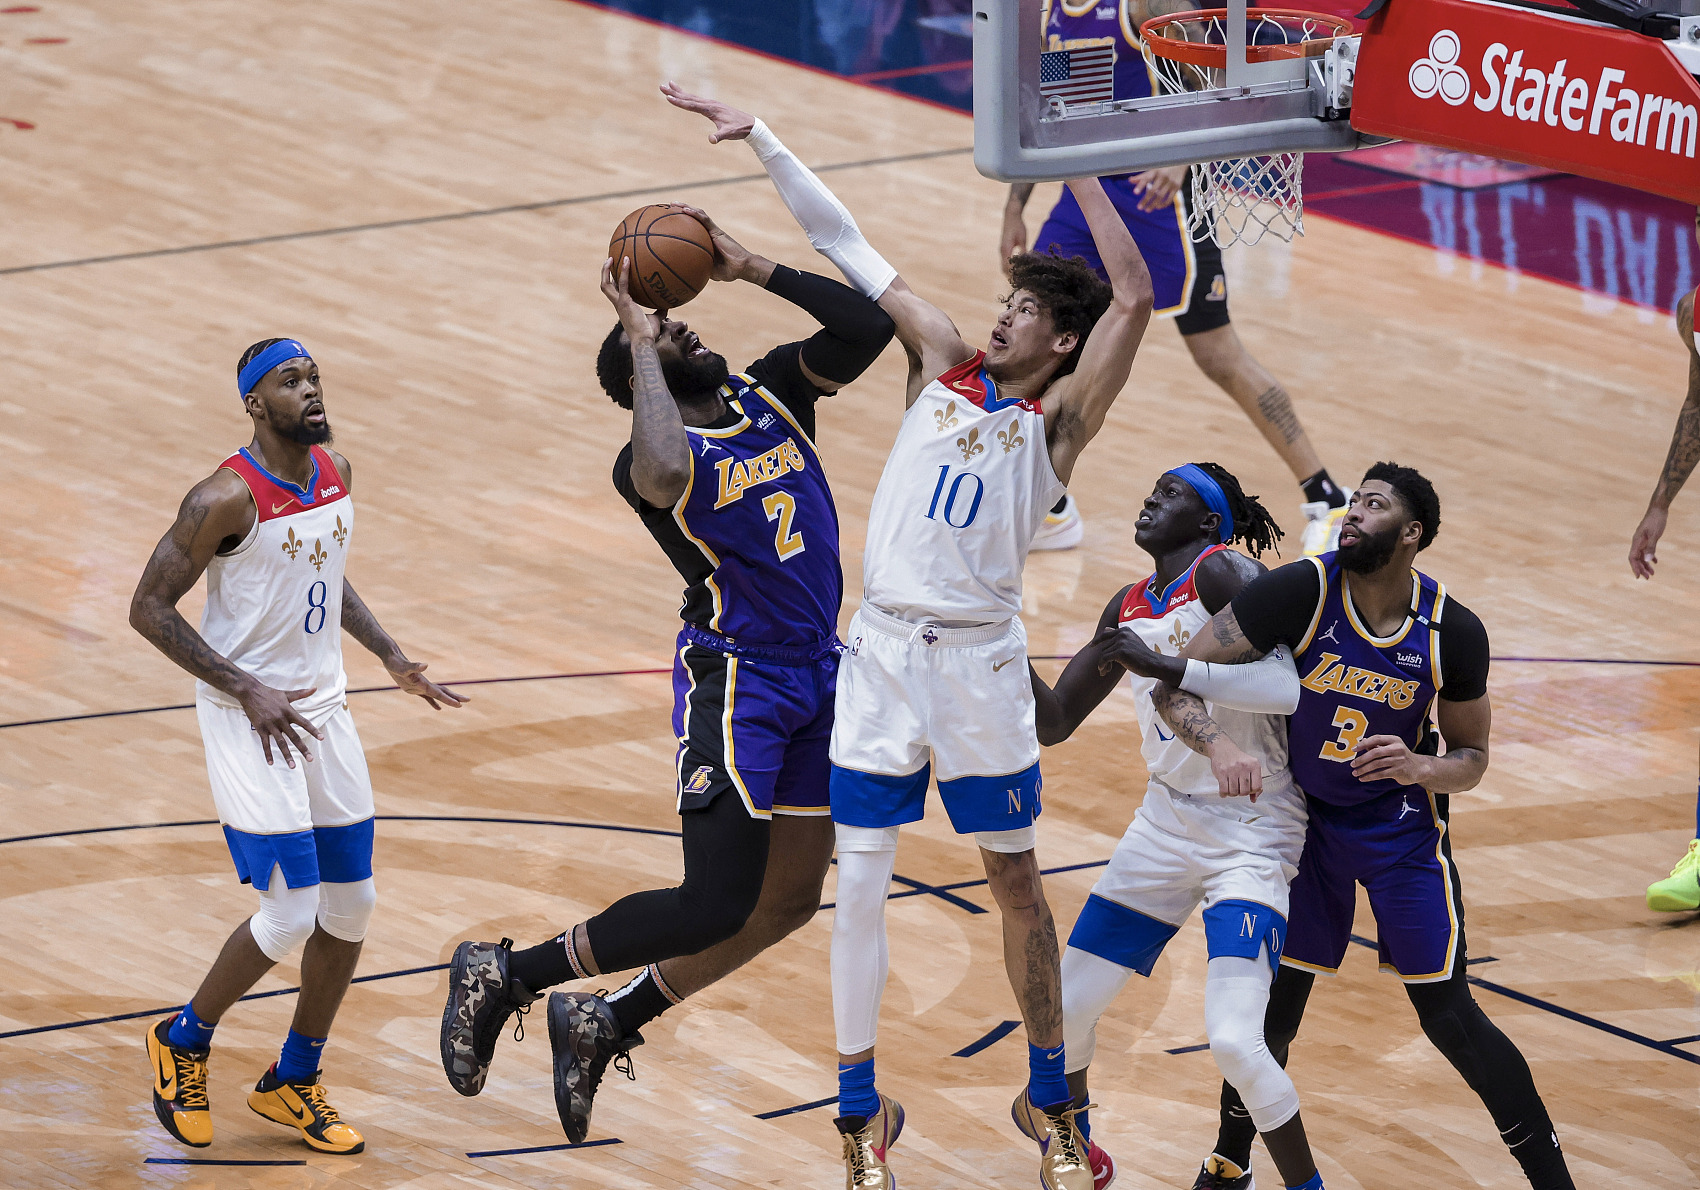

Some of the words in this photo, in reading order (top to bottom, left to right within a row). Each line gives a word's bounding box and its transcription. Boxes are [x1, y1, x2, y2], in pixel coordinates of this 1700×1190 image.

[320, 485, 340, 499] ibotta
[714, 437, 805, 511] LAKERS
[924, 464, 984, 529] 10
[762, 490, 805, 563] 2
[304, 581, 327, 635] 8
[1169, 592, 1189, 606] ibott
[1300, 651, 1421, 710] LAKERS
[1396, 652, 1423, 664] wish
[1318, 705, 1369, 763] 3
